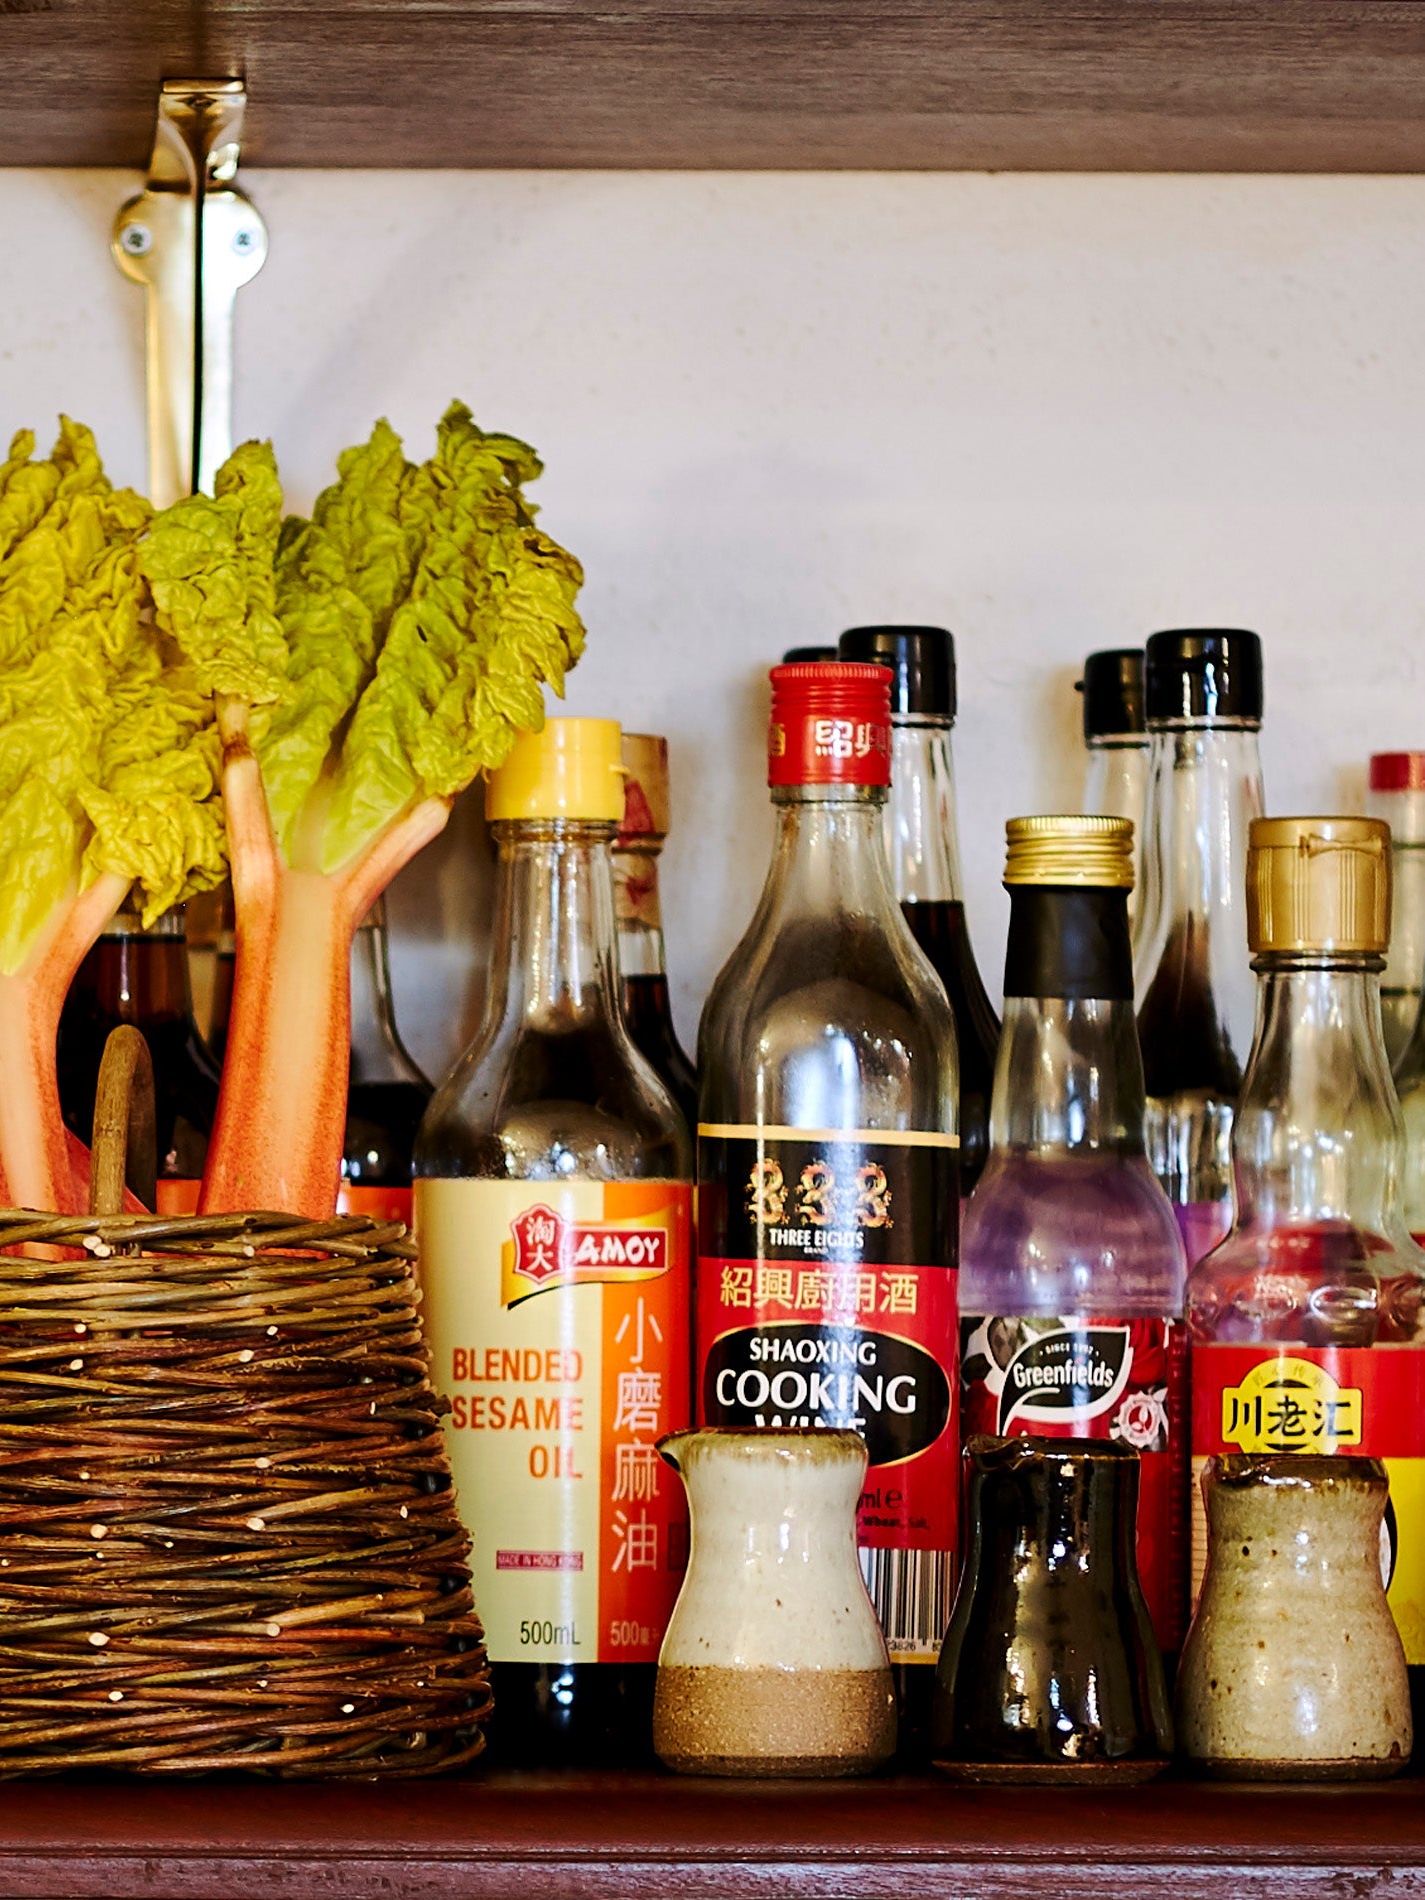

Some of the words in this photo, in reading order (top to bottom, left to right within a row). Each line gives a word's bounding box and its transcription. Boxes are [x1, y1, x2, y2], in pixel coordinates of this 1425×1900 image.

[573, 1234, 660, 1265] AMOY
[769, 1228, 811, 1248] THREE
[814, 1228, 864, 1250] EIGHTS
[452, 1348, 583, 1383] BLENDED
[750, 1338, 876, 1366] SHAOXING
[716, 1368, 916, 1414] COOKING
[1013, 1359, 1114, 1391] Greenfields
[452, 1396, 583, 1431] SESAME
[1229, 1394, 1355, 1438] 川老汇
[611, 1297, 662, 1573] 小磨麻油
[528, 1445, 583, 1479] OIL
[499, 1555, 520, 1566] MADE
[523, 1555, 531, 1566] IN
[534, 1555, 557, 1567] HONG
[520, 1621, 581, 1645] 500mL
